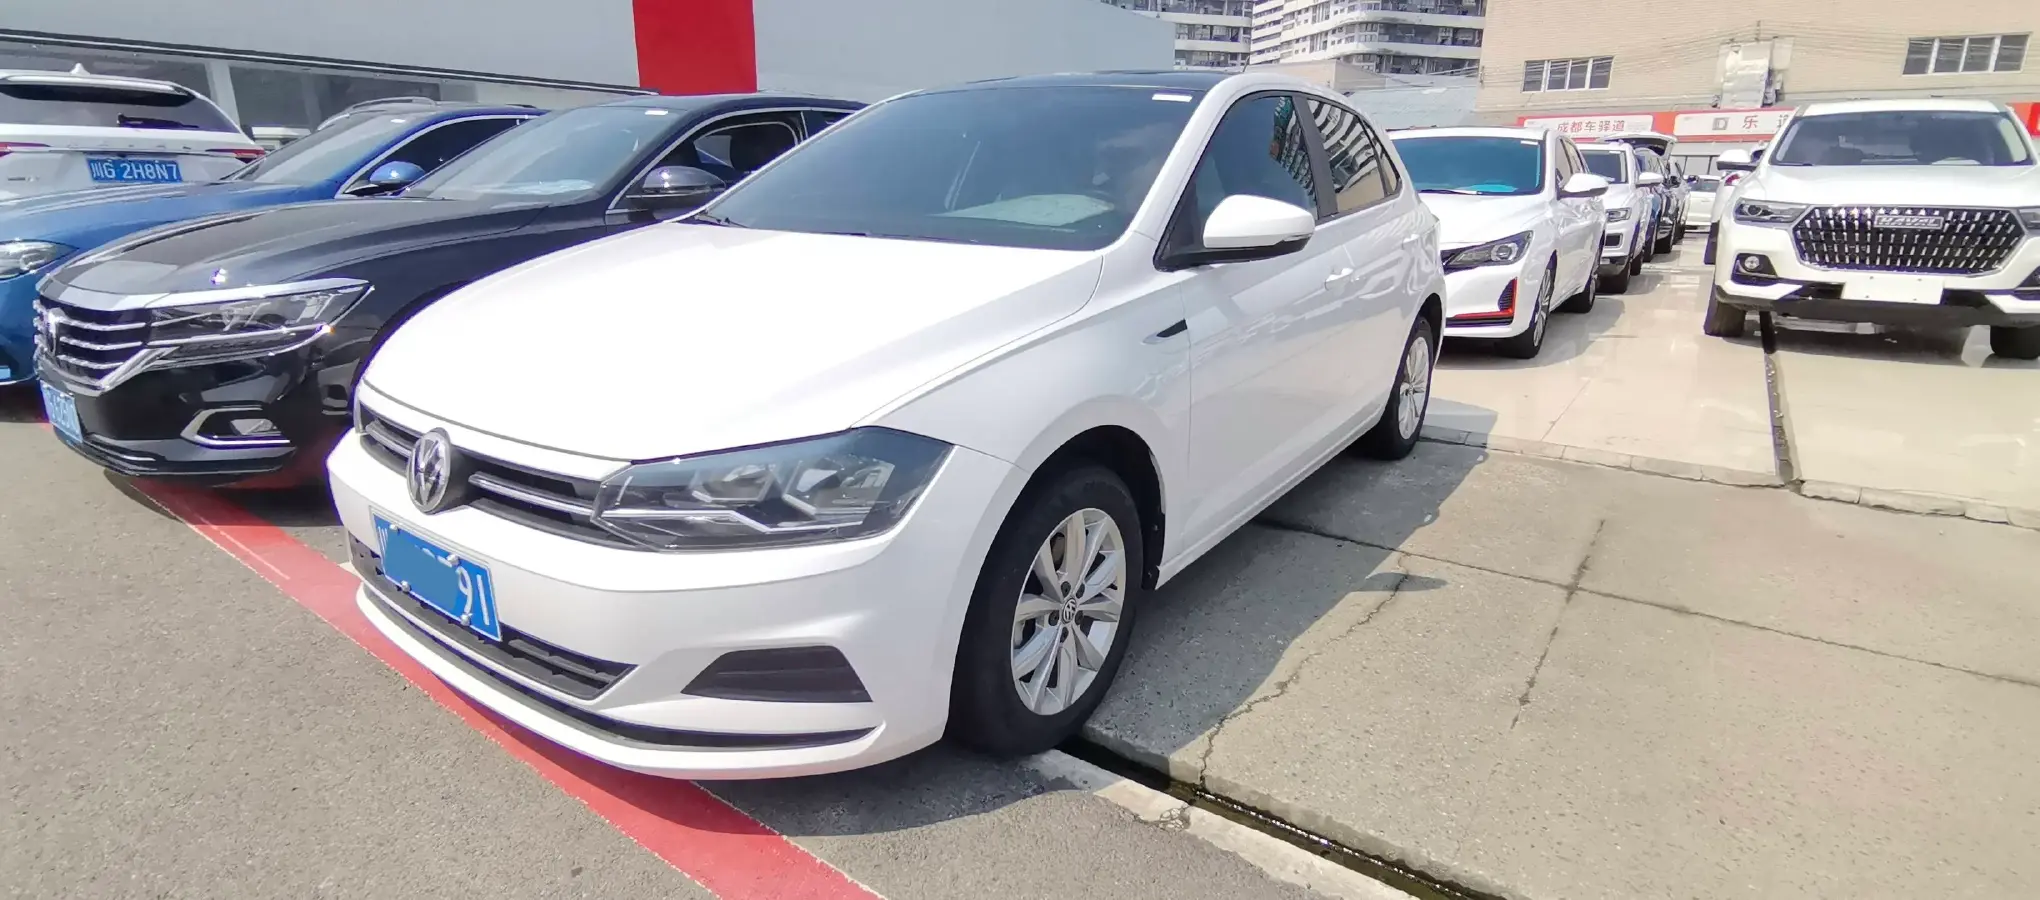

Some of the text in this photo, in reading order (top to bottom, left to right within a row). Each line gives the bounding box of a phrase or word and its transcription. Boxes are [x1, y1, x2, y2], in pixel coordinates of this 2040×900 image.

[1557, 120, 1625, 133] 成都车驿道
[120, 160, 178, 179] 2H8N7
[1878, 217, 1939, 227] HAVAL
